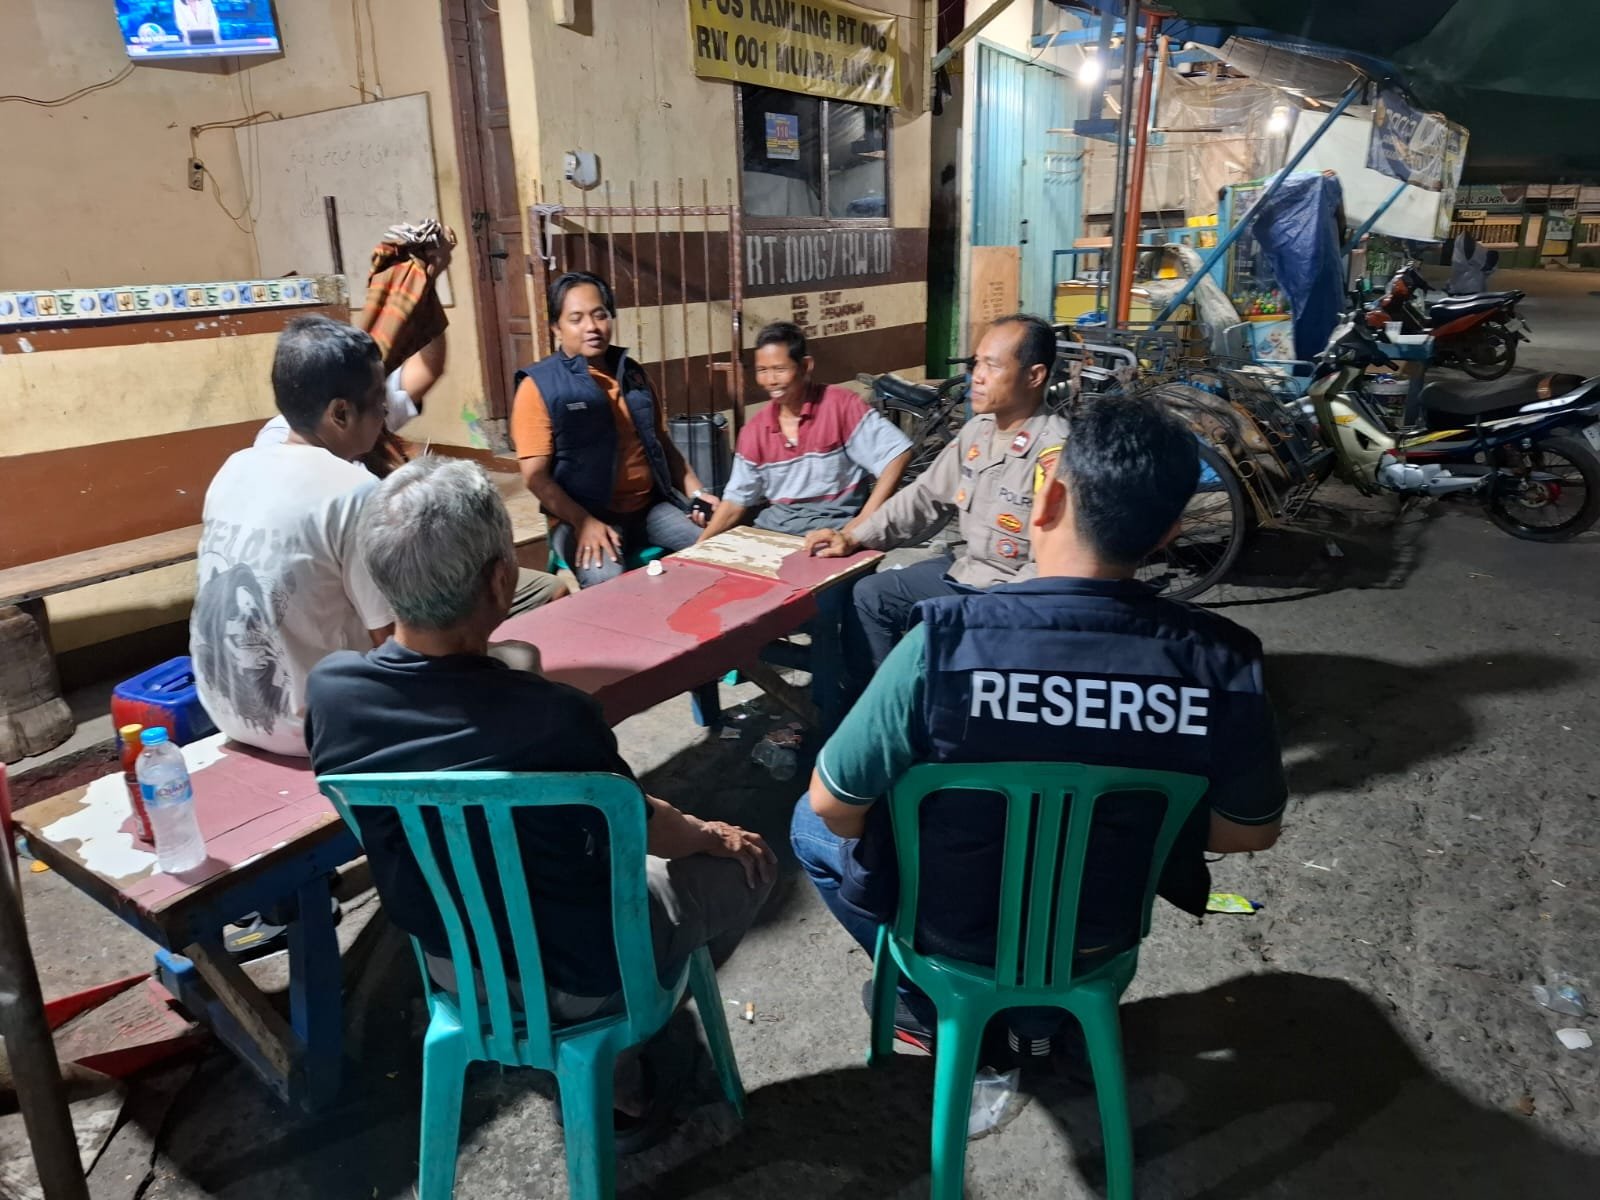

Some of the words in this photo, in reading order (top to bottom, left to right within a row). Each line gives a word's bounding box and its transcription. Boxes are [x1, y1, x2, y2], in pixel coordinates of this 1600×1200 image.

[751, 0, 831, 39] KAMLING
[837, 15, 856, 45] RT
[861, 23, 887, 53] 006
[696, 25, 728, 61] RW
[735, 34, 767, 69] 001
[776, 42, 835, 82] MUARA
[841, 58, 889, 90] ANGK
[999, 487, 1033, 507] POLR
[970, 671, 1209, 735] RESERSE
